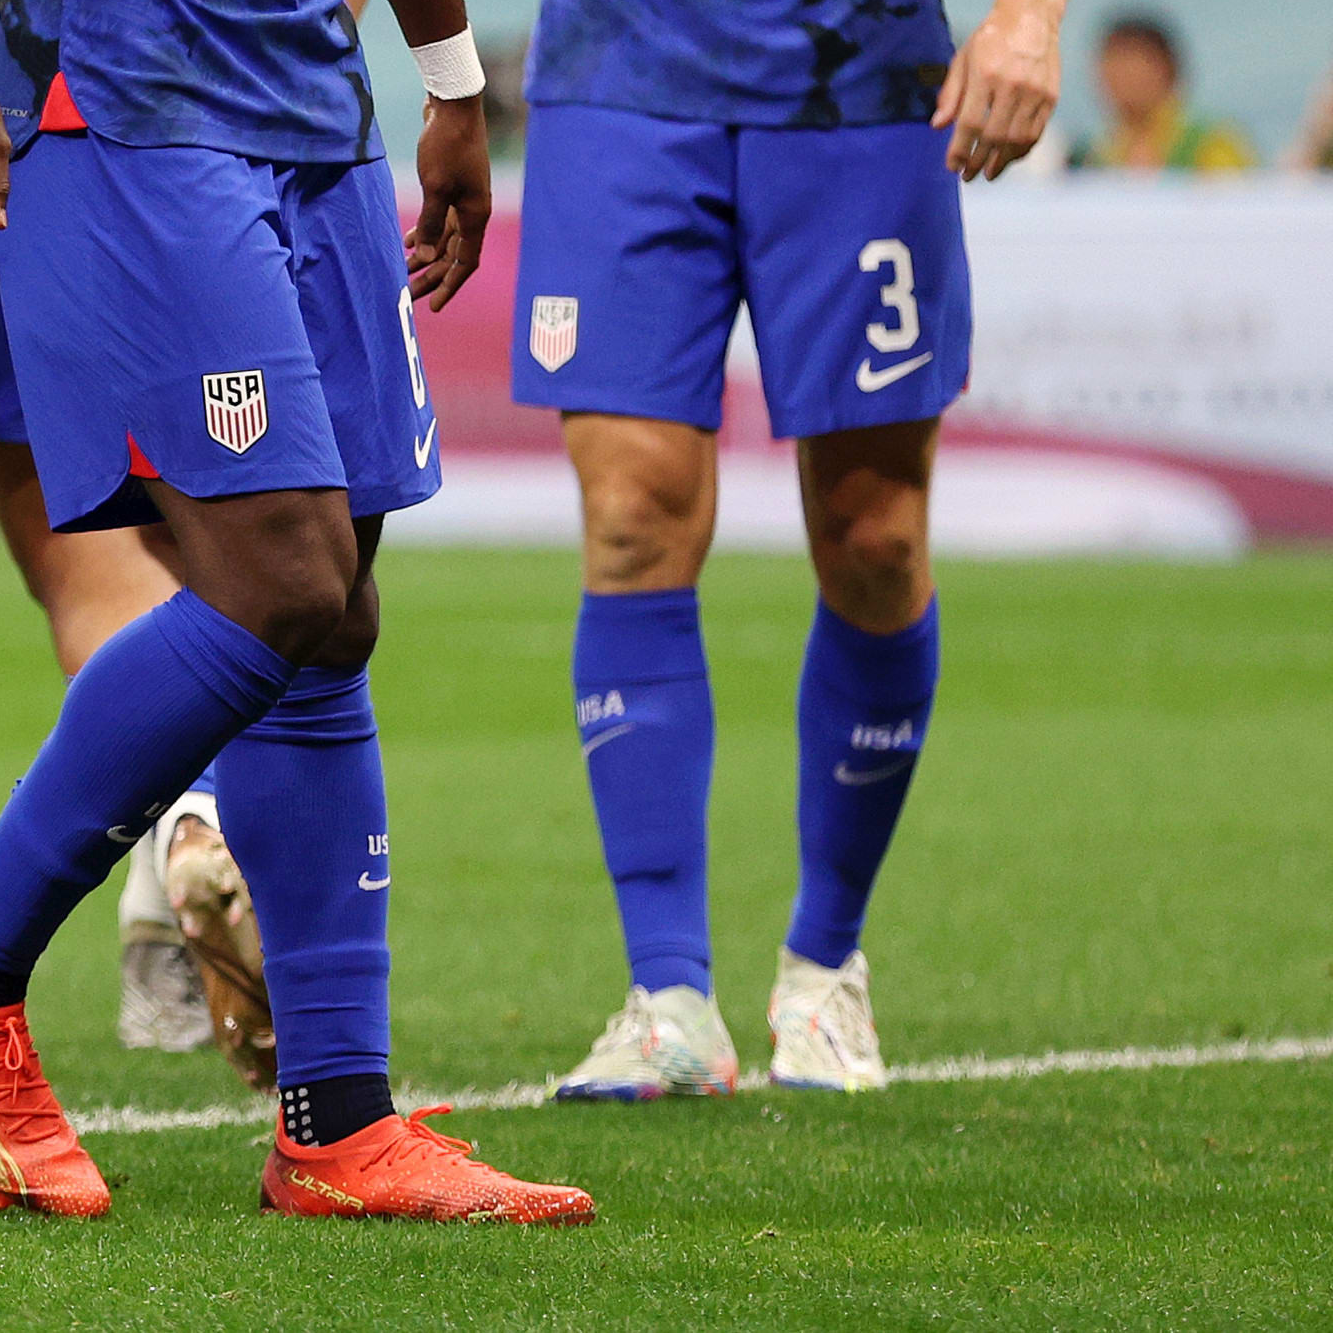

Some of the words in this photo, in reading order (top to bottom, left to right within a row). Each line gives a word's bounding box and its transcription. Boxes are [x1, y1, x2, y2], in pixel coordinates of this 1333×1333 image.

[858, 238, 920, 353] 3
[398, 285, 425, 409] 6
[208, 375, 259, 407] USA
[851, 719, 912, 750] USA
[290, 1169, 363, 1210] ULTRA
